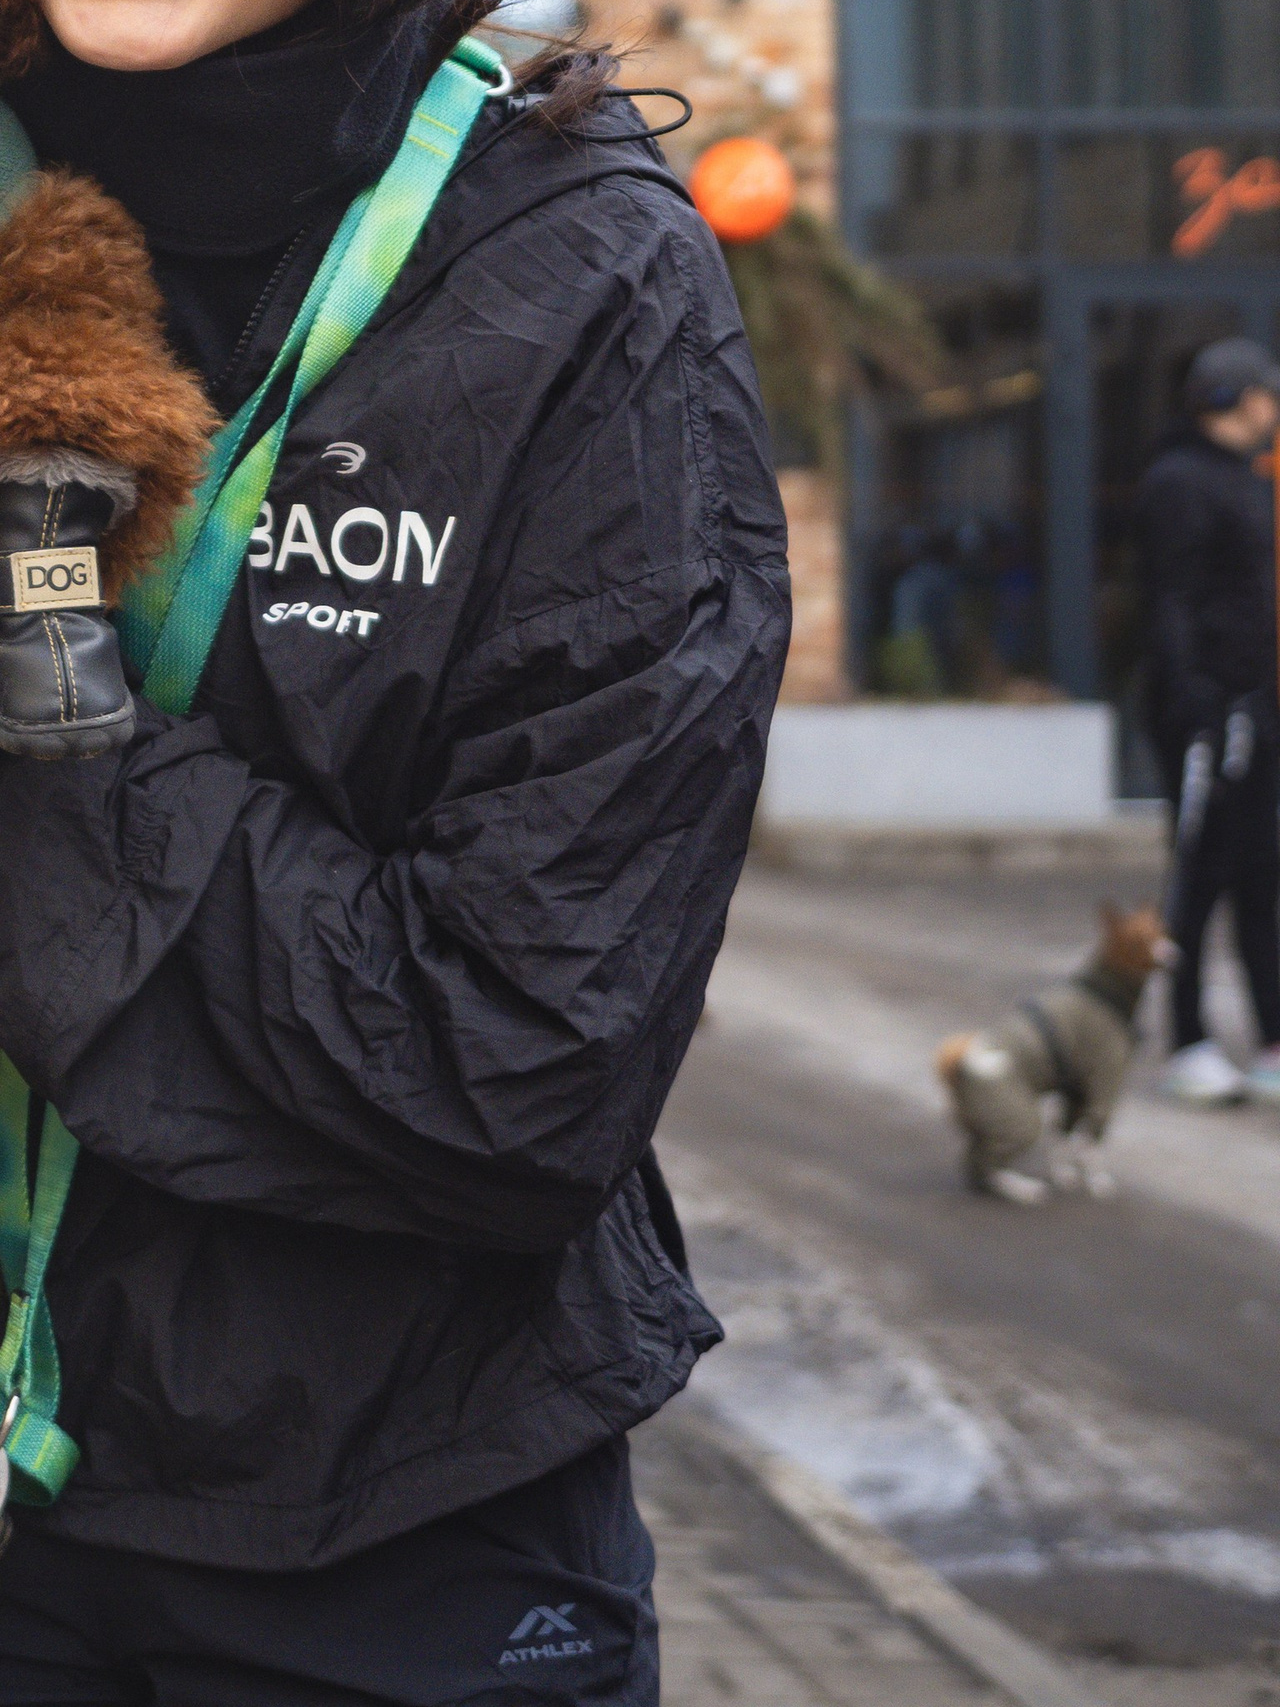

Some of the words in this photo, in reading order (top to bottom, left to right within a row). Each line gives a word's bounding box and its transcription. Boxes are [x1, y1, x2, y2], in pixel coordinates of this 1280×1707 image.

[249, 500, 456, 584] BAON
[26, 562, 87, 592] DOG
[498, 1639, 593, 1665] ATHLEX
